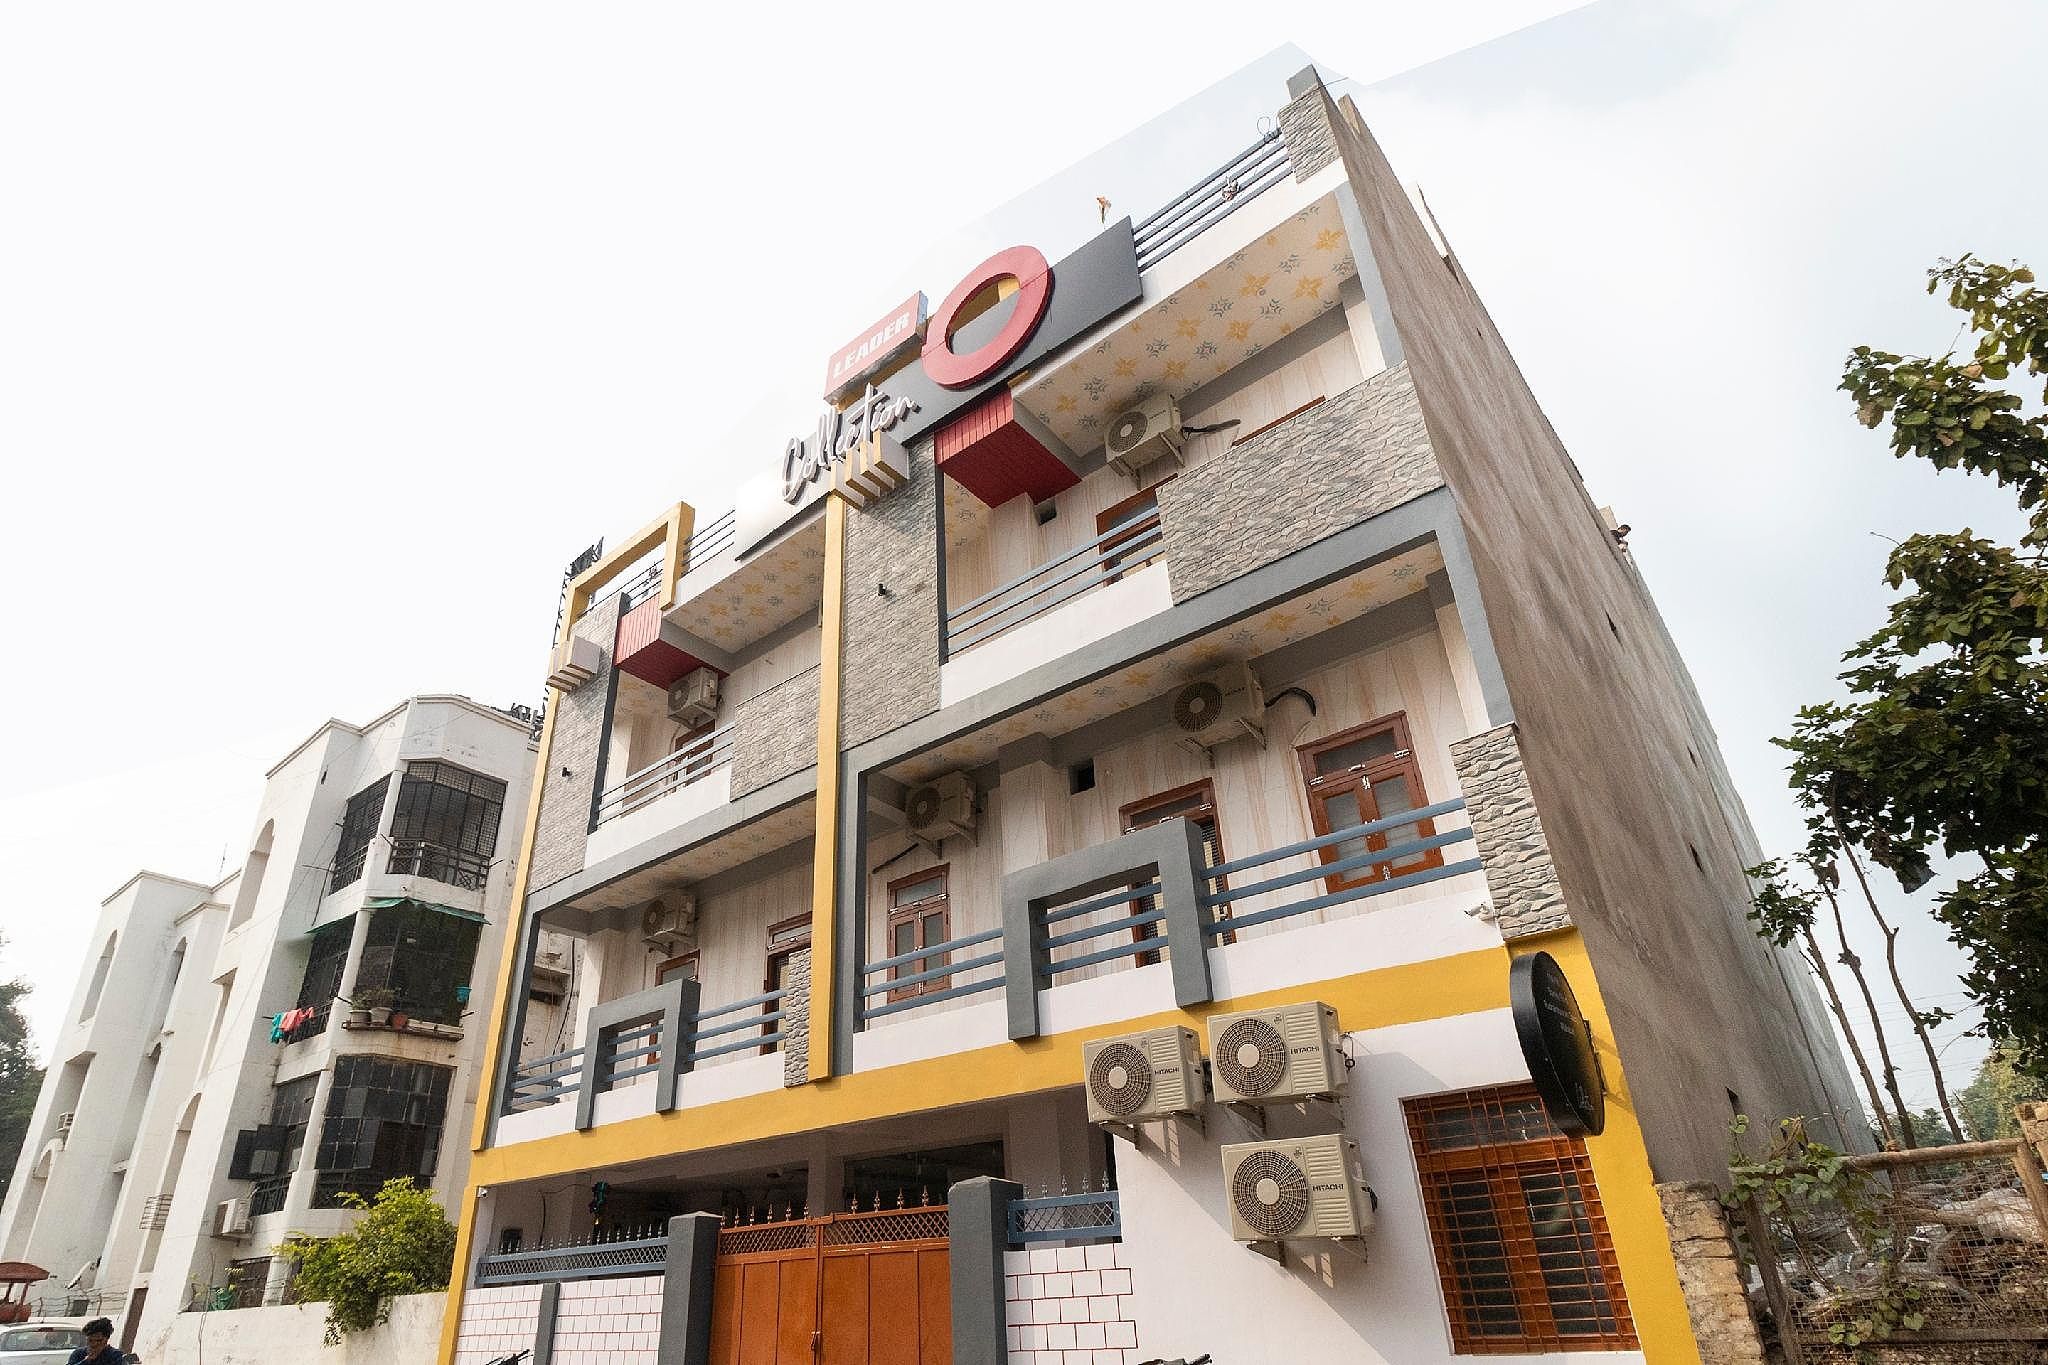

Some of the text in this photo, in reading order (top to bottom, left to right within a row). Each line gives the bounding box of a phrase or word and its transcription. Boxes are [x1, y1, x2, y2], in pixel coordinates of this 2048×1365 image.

[832, 311, 910, 379] LEADER
[1290, 1046, 1320, 1055] HITACHI
[1154, 1066, 1180, 1075] HITACHI
[1312, 1183, 1344, 1192] HITACHI
